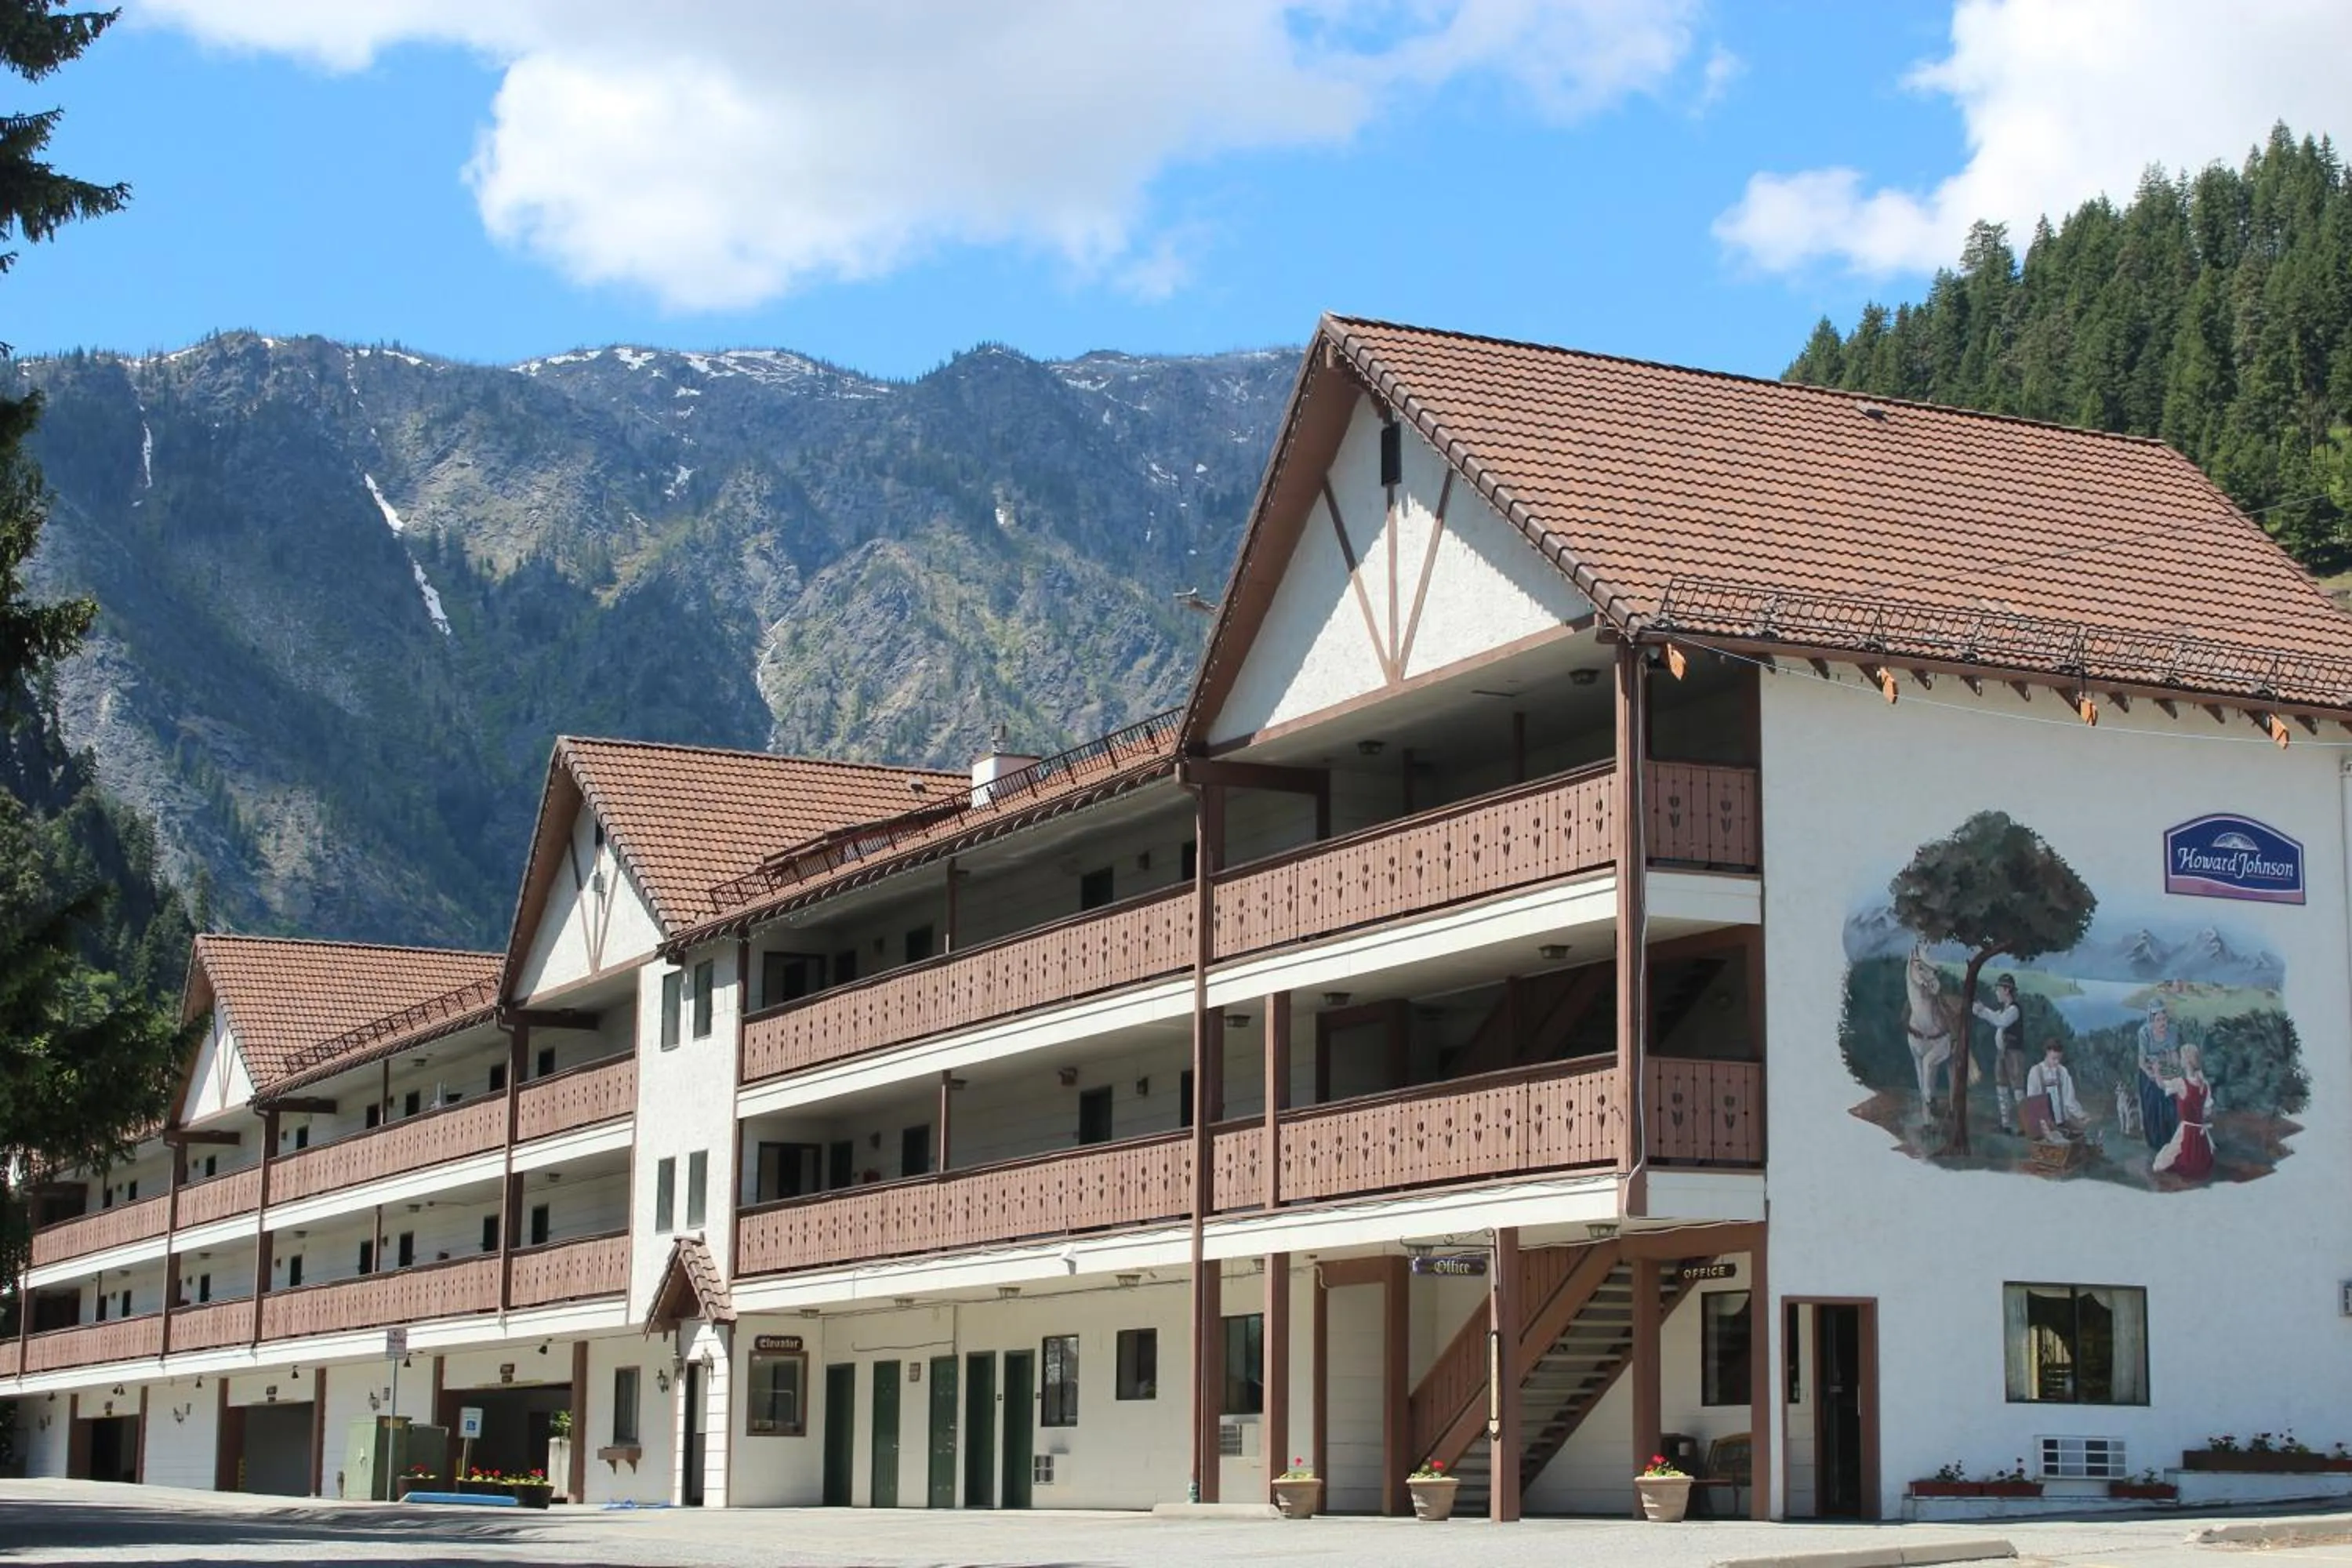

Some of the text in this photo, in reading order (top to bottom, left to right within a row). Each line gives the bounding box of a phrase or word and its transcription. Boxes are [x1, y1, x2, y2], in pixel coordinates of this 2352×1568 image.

[2178, 848, 2293, 879] Howard Johnson
[1434, 1260, 1470, 1274] Office
[1683, 1266, 1726, 1279] OFFICE
